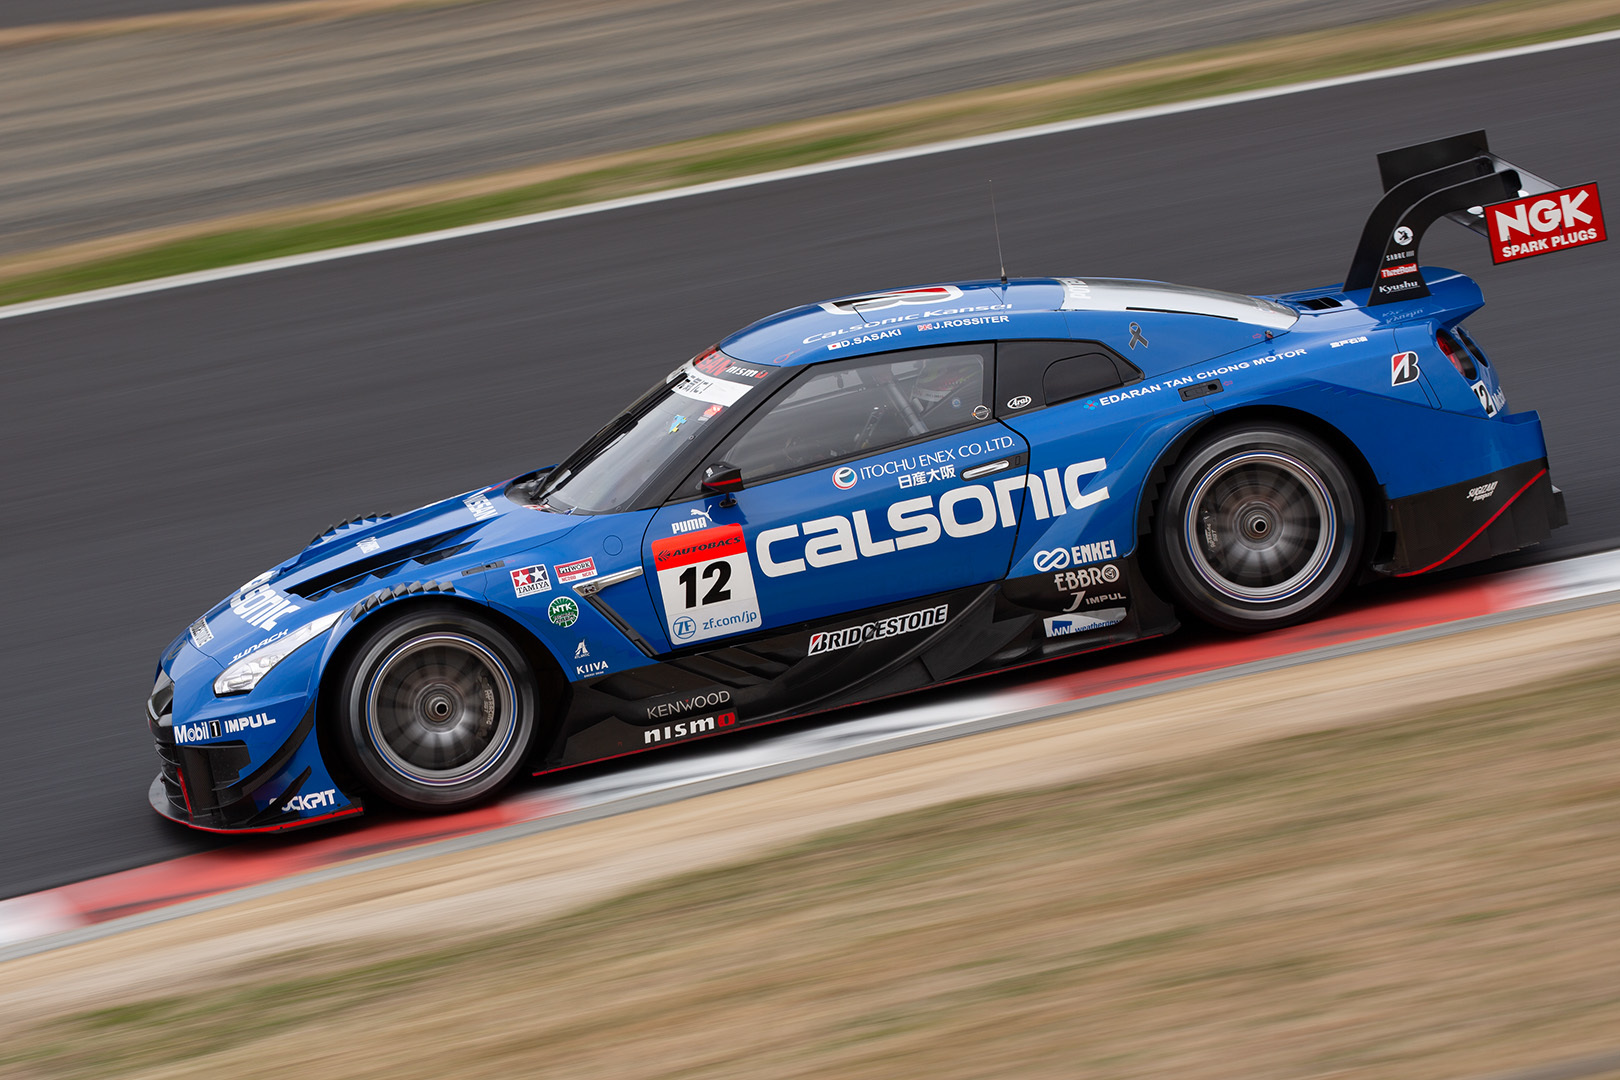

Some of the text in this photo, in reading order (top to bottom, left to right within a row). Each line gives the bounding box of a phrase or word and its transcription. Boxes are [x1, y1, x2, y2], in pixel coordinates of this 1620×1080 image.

[1495, 190, 1594, 242] NGK
[1502, 228, 1597, 258] SPARK PLUGS
[1379, 280, 1418, 294] Kyushu
[933, 315, 1010, 330] J.ROSSITER
[841, 328, 902, 348] D.SASAKI
[1099, 348, 1307, 406] EDARAN TAN CHONG MOTOR
[860, 456, 916, 481] ITOCHU
[919, 448, 956, 468] ENEX
[898, 464, 956, 489] 日産大阪
[671, 517, 707, 534] PUMA
[672, 536, 741, 557] AUTOBACS
[1071, 539, 1117, 565] ENKEI
[516, 581, 550, 594] TAMIYA
[678, 560, 732, 610] 12
[1054, 563, 1120, 592] EBBRO
[552, 602, 572, 615] NTK
[1085, 592, 1126, 605] IMPUL
[702, 611, 757, 630] zf.com/jp
[807, 604, 949, 656] BRIDGESTONE
[576, 660, 609, 675] KIIVA
[646, 690, 730, 720] KENWOOD
[174, 712, 276, 744] Mobil 1 IMPUL
[644, 711, 736, 744] nismo
[269, 789, 336, 812] CKPIT
